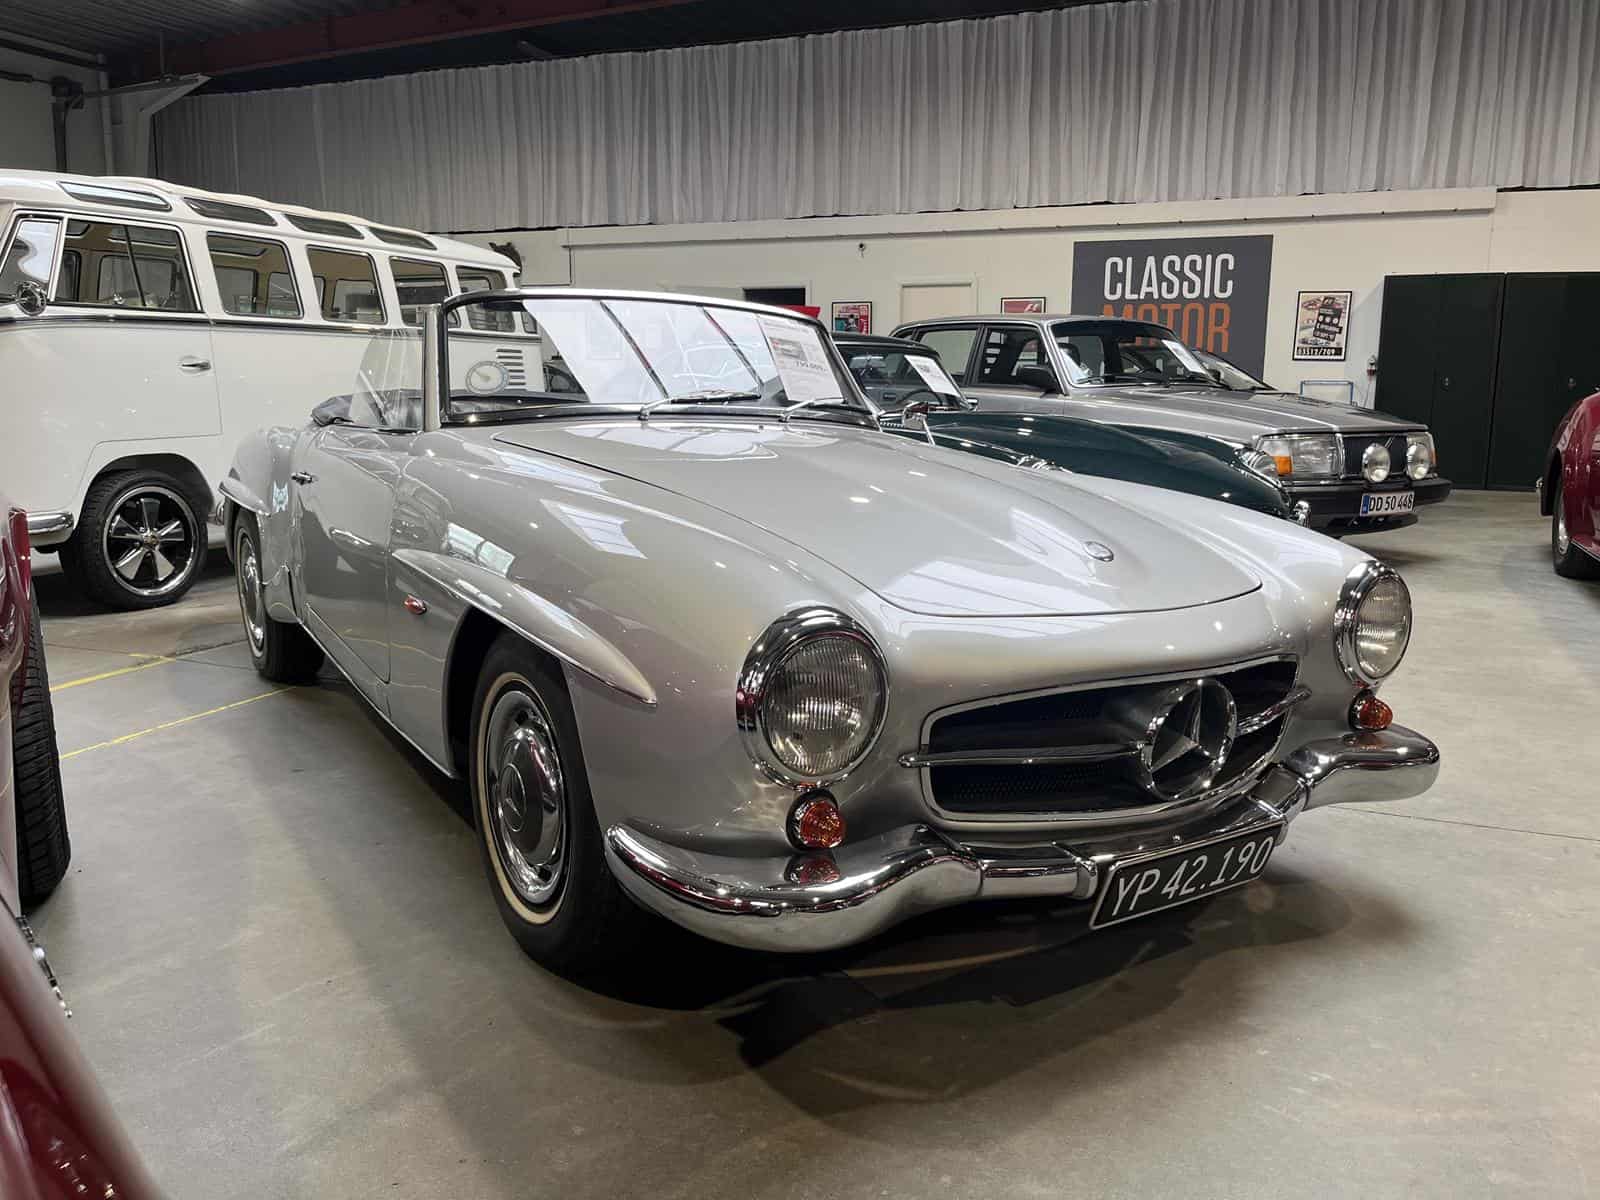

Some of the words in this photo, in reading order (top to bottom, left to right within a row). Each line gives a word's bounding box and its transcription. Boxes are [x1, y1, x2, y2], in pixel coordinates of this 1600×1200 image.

[1103, 253, 1235, 301] CLASSIC
[1369, 496, 1384, 512] DD
[1385, 495, 1397, 511] 50
[1398, 493, 1413, 510] 448
[1111, 868, 1161, 916] YP
[1160, 836, 1274, 899] 42.190
